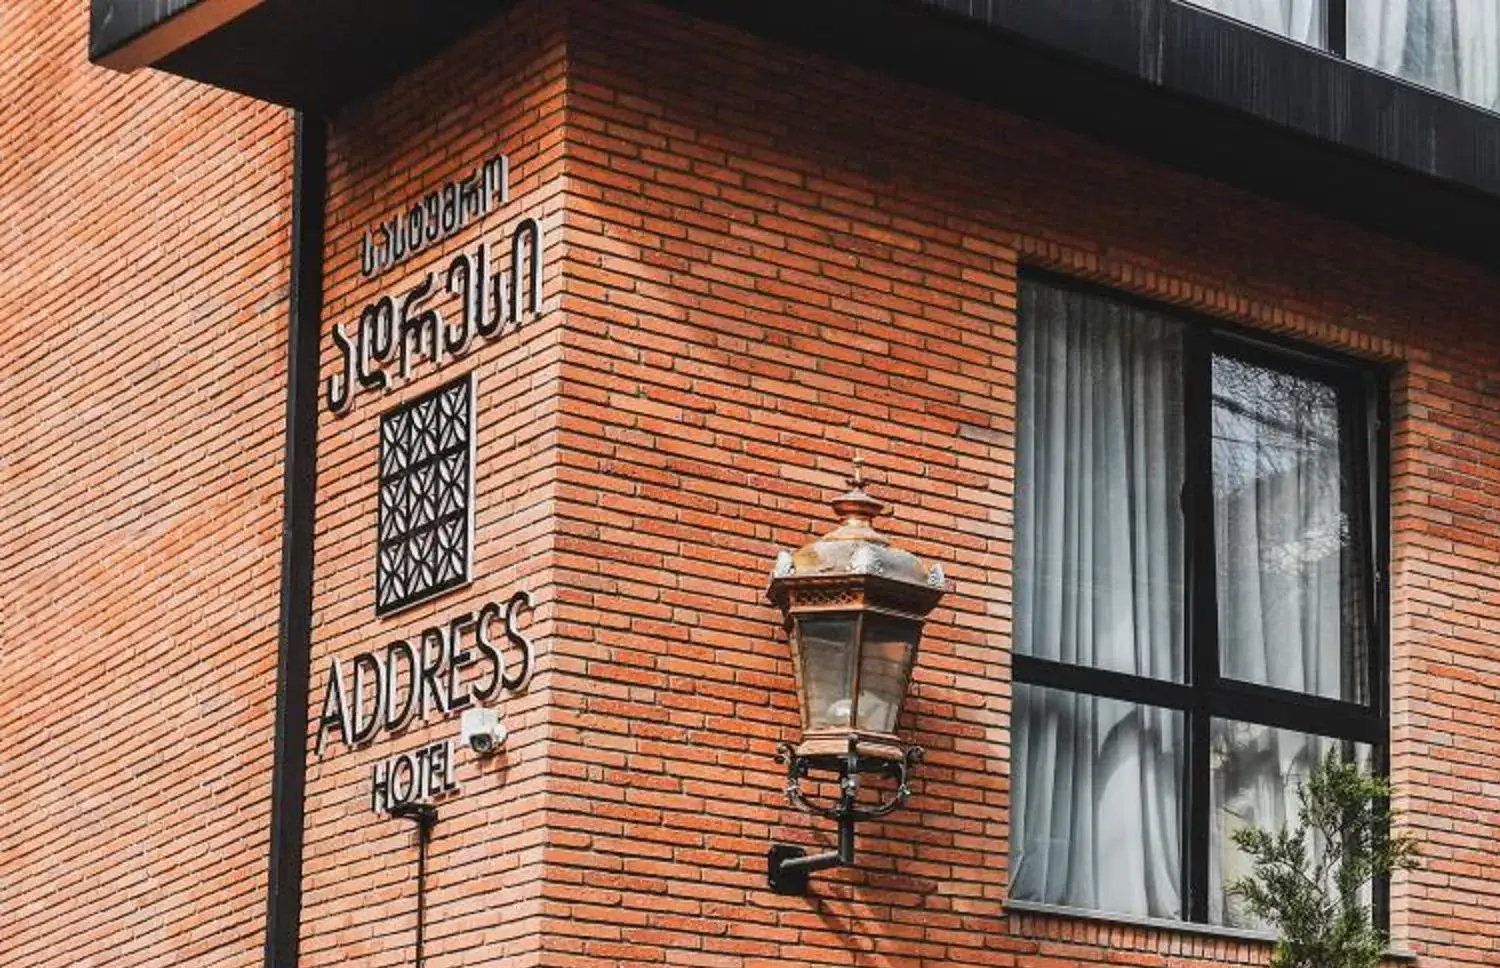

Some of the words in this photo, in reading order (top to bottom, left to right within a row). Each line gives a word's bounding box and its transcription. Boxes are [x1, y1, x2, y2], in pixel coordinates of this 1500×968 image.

[361, 154, 508, 277] სასტუმრო
[327, 217, 543, 415] ადრესი
[315, 590, 535, 757] ADDRESS
[371, 741, 457, 813] HOTEL
